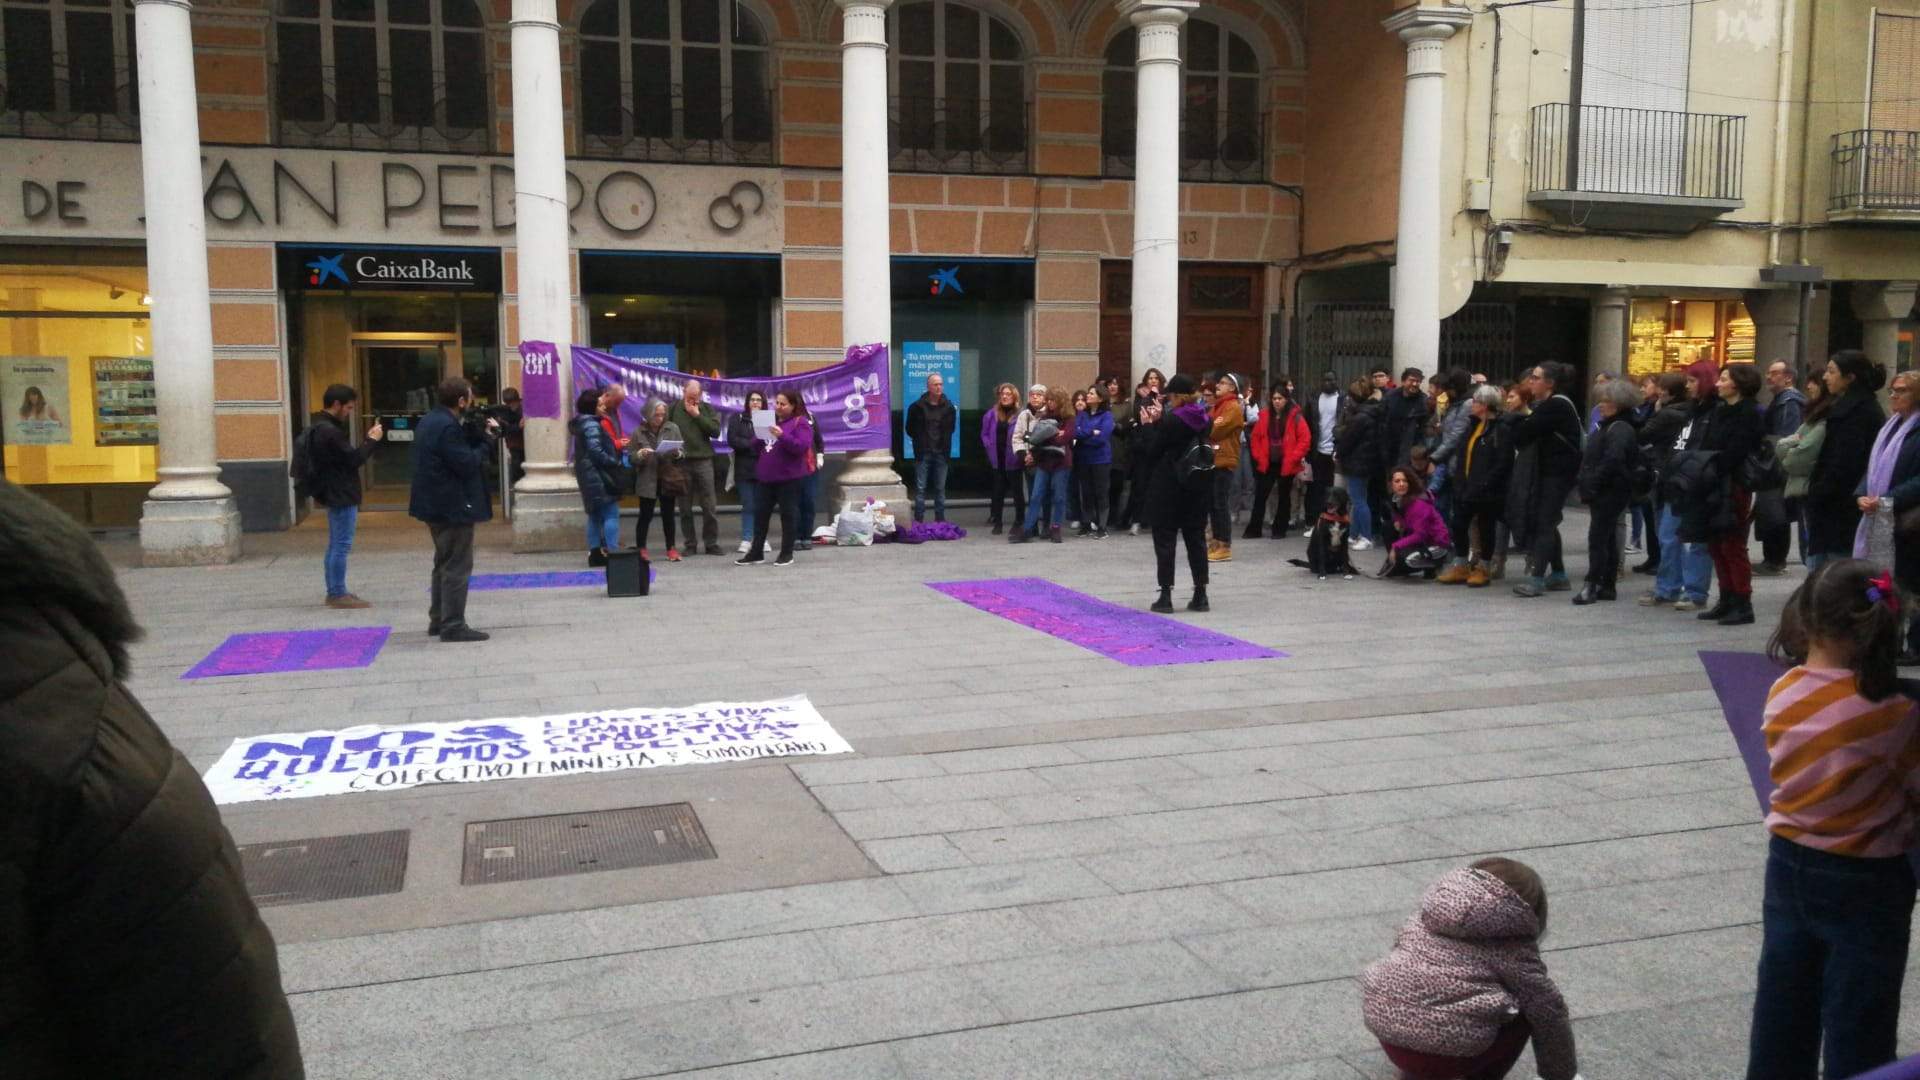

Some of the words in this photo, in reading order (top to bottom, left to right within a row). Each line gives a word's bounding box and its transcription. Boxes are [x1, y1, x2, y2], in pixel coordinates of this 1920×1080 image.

[22, 180, 87, 223] DE
[356, 256, 475, 280] CaixaBank
[524, 352, 552, 376] 8M
[630, 357, 669, 365] mereces
[928, 363, 942, 372] por
[233, 742, 531, 780] QUEREMOS
[349, 762, 513, 789] COLECTIVO
